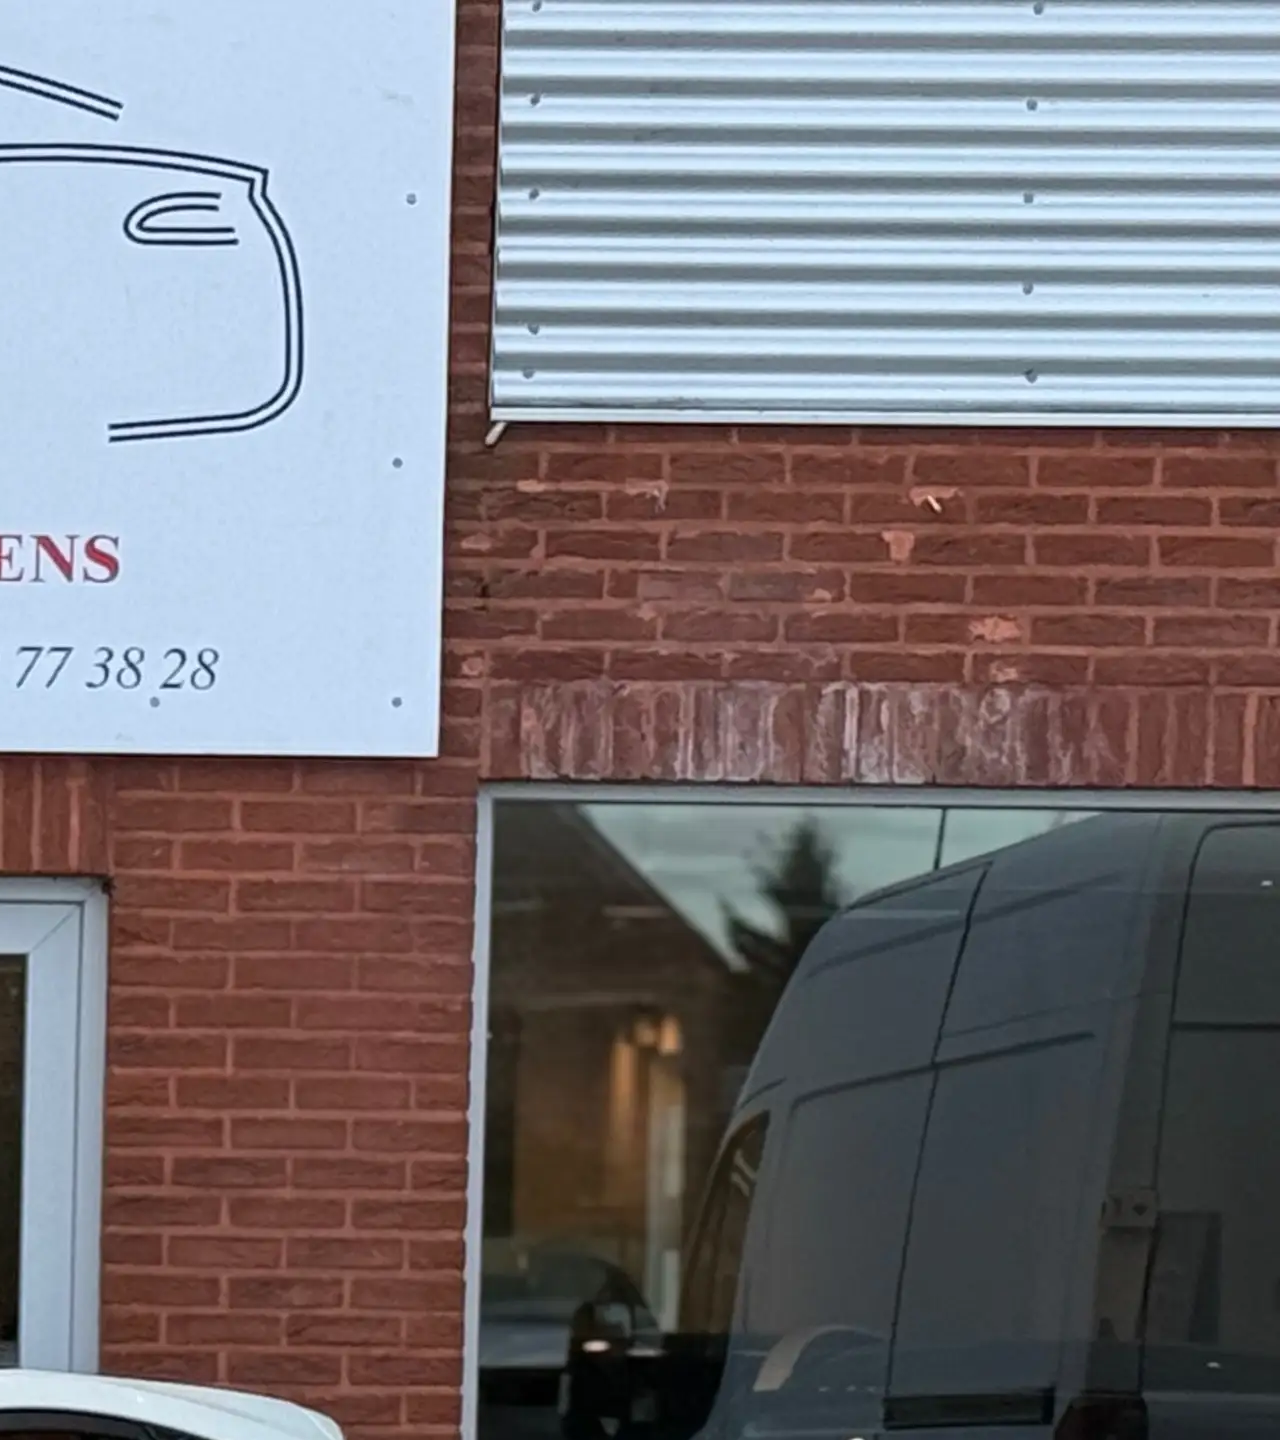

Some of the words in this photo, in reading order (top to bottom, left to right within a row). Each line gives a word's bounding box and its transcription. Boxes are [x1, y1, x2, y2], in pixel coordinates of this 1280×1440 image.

[16, 646, 73, 688] 77
[86, 647, 144, 689] 38
[160, 648, 219, 689] 28
